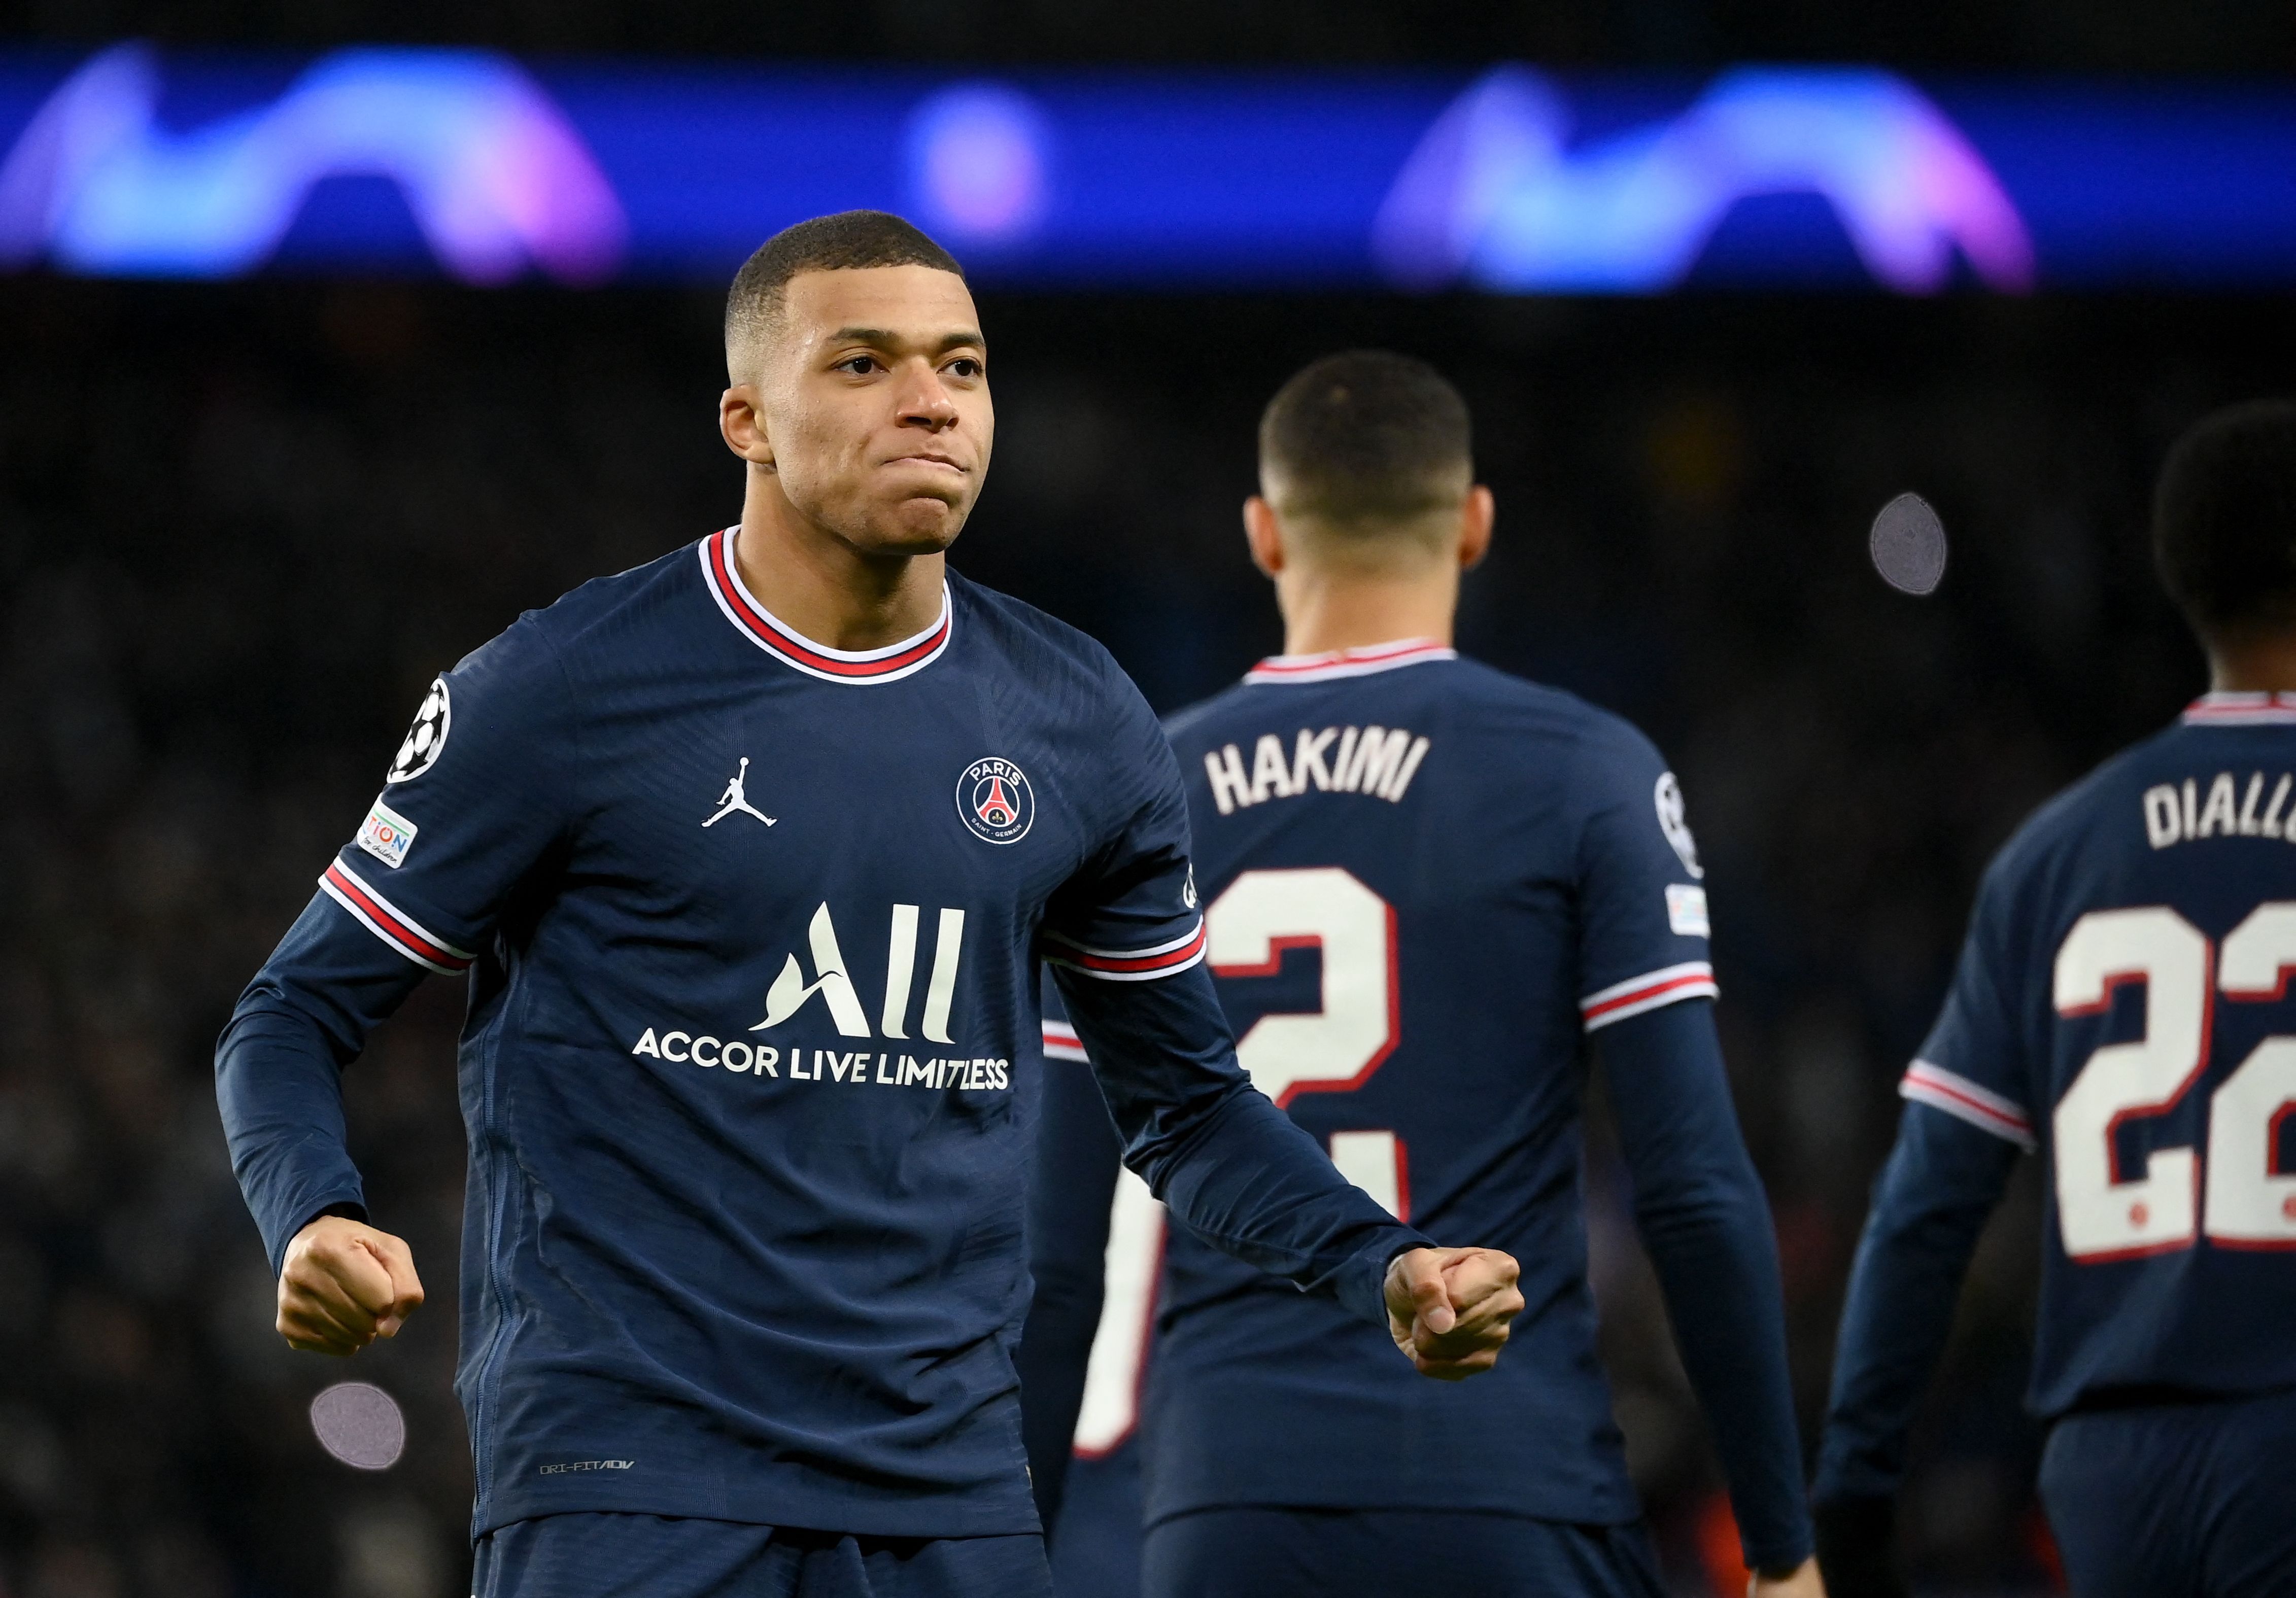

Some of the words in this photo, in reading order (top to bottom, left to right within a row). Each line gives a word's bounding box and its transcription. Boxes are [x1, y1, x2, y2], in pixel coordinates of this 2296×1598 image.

[969, 761, 1021, 786] PARIS
[1204, 725, 1431, 815] HAKIMI
[971, 817, 990, 834] SAINT
[995, 823, 1022, 837] GERMAIN
[632, 1027, 779, 1078] ACCOR
[790, 1049, 871, 1083] LIVE
[876, 1053, 1009, 1090] LIMITLESS
[1204, 866, 1410, 1224] 2
[2052, 902, 2296, 1265] 22
